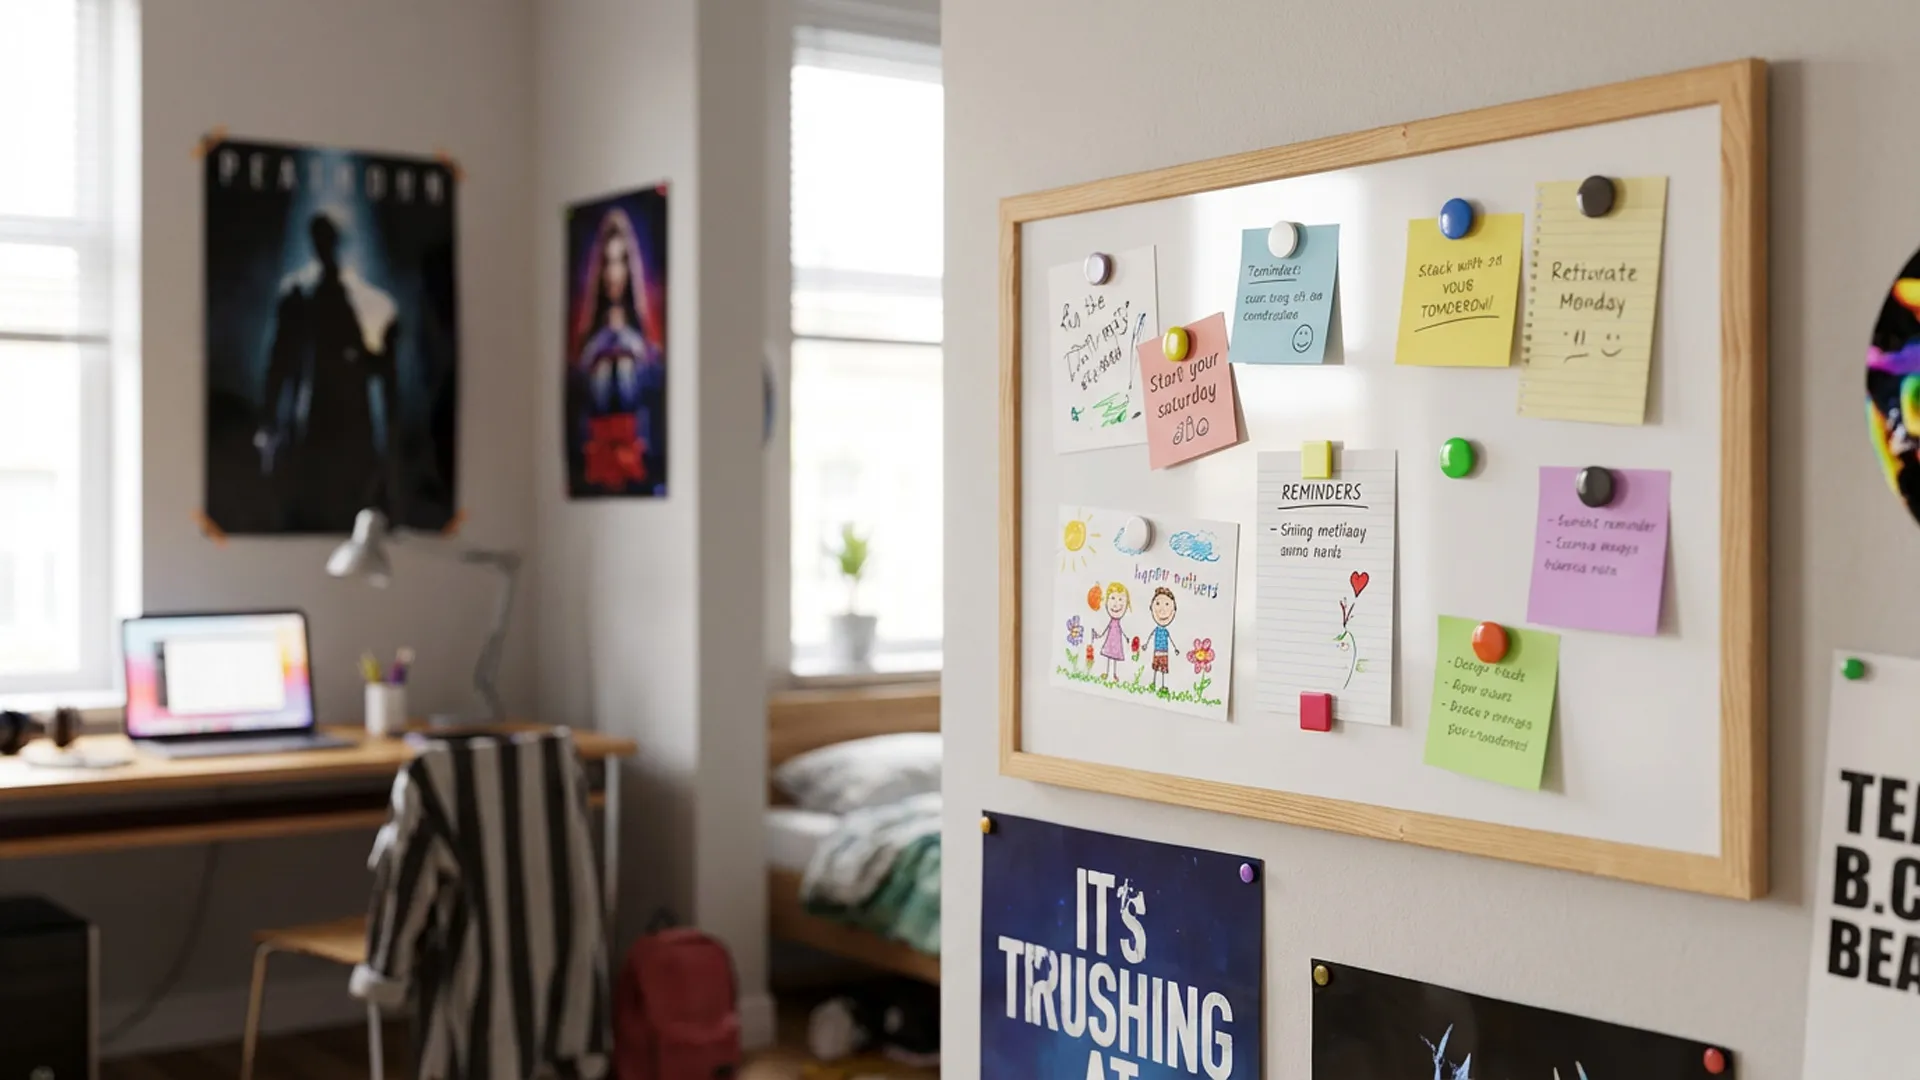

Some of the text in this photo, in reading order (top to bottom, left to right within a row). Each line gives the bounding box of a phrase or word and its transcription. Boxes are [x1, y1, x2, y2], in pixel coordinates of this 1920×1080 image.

[1559, 291, 1626, 319] Monday
[1189, 352, 1219, 382] your
[1281, 483, 1362, 501] REMINDERS
